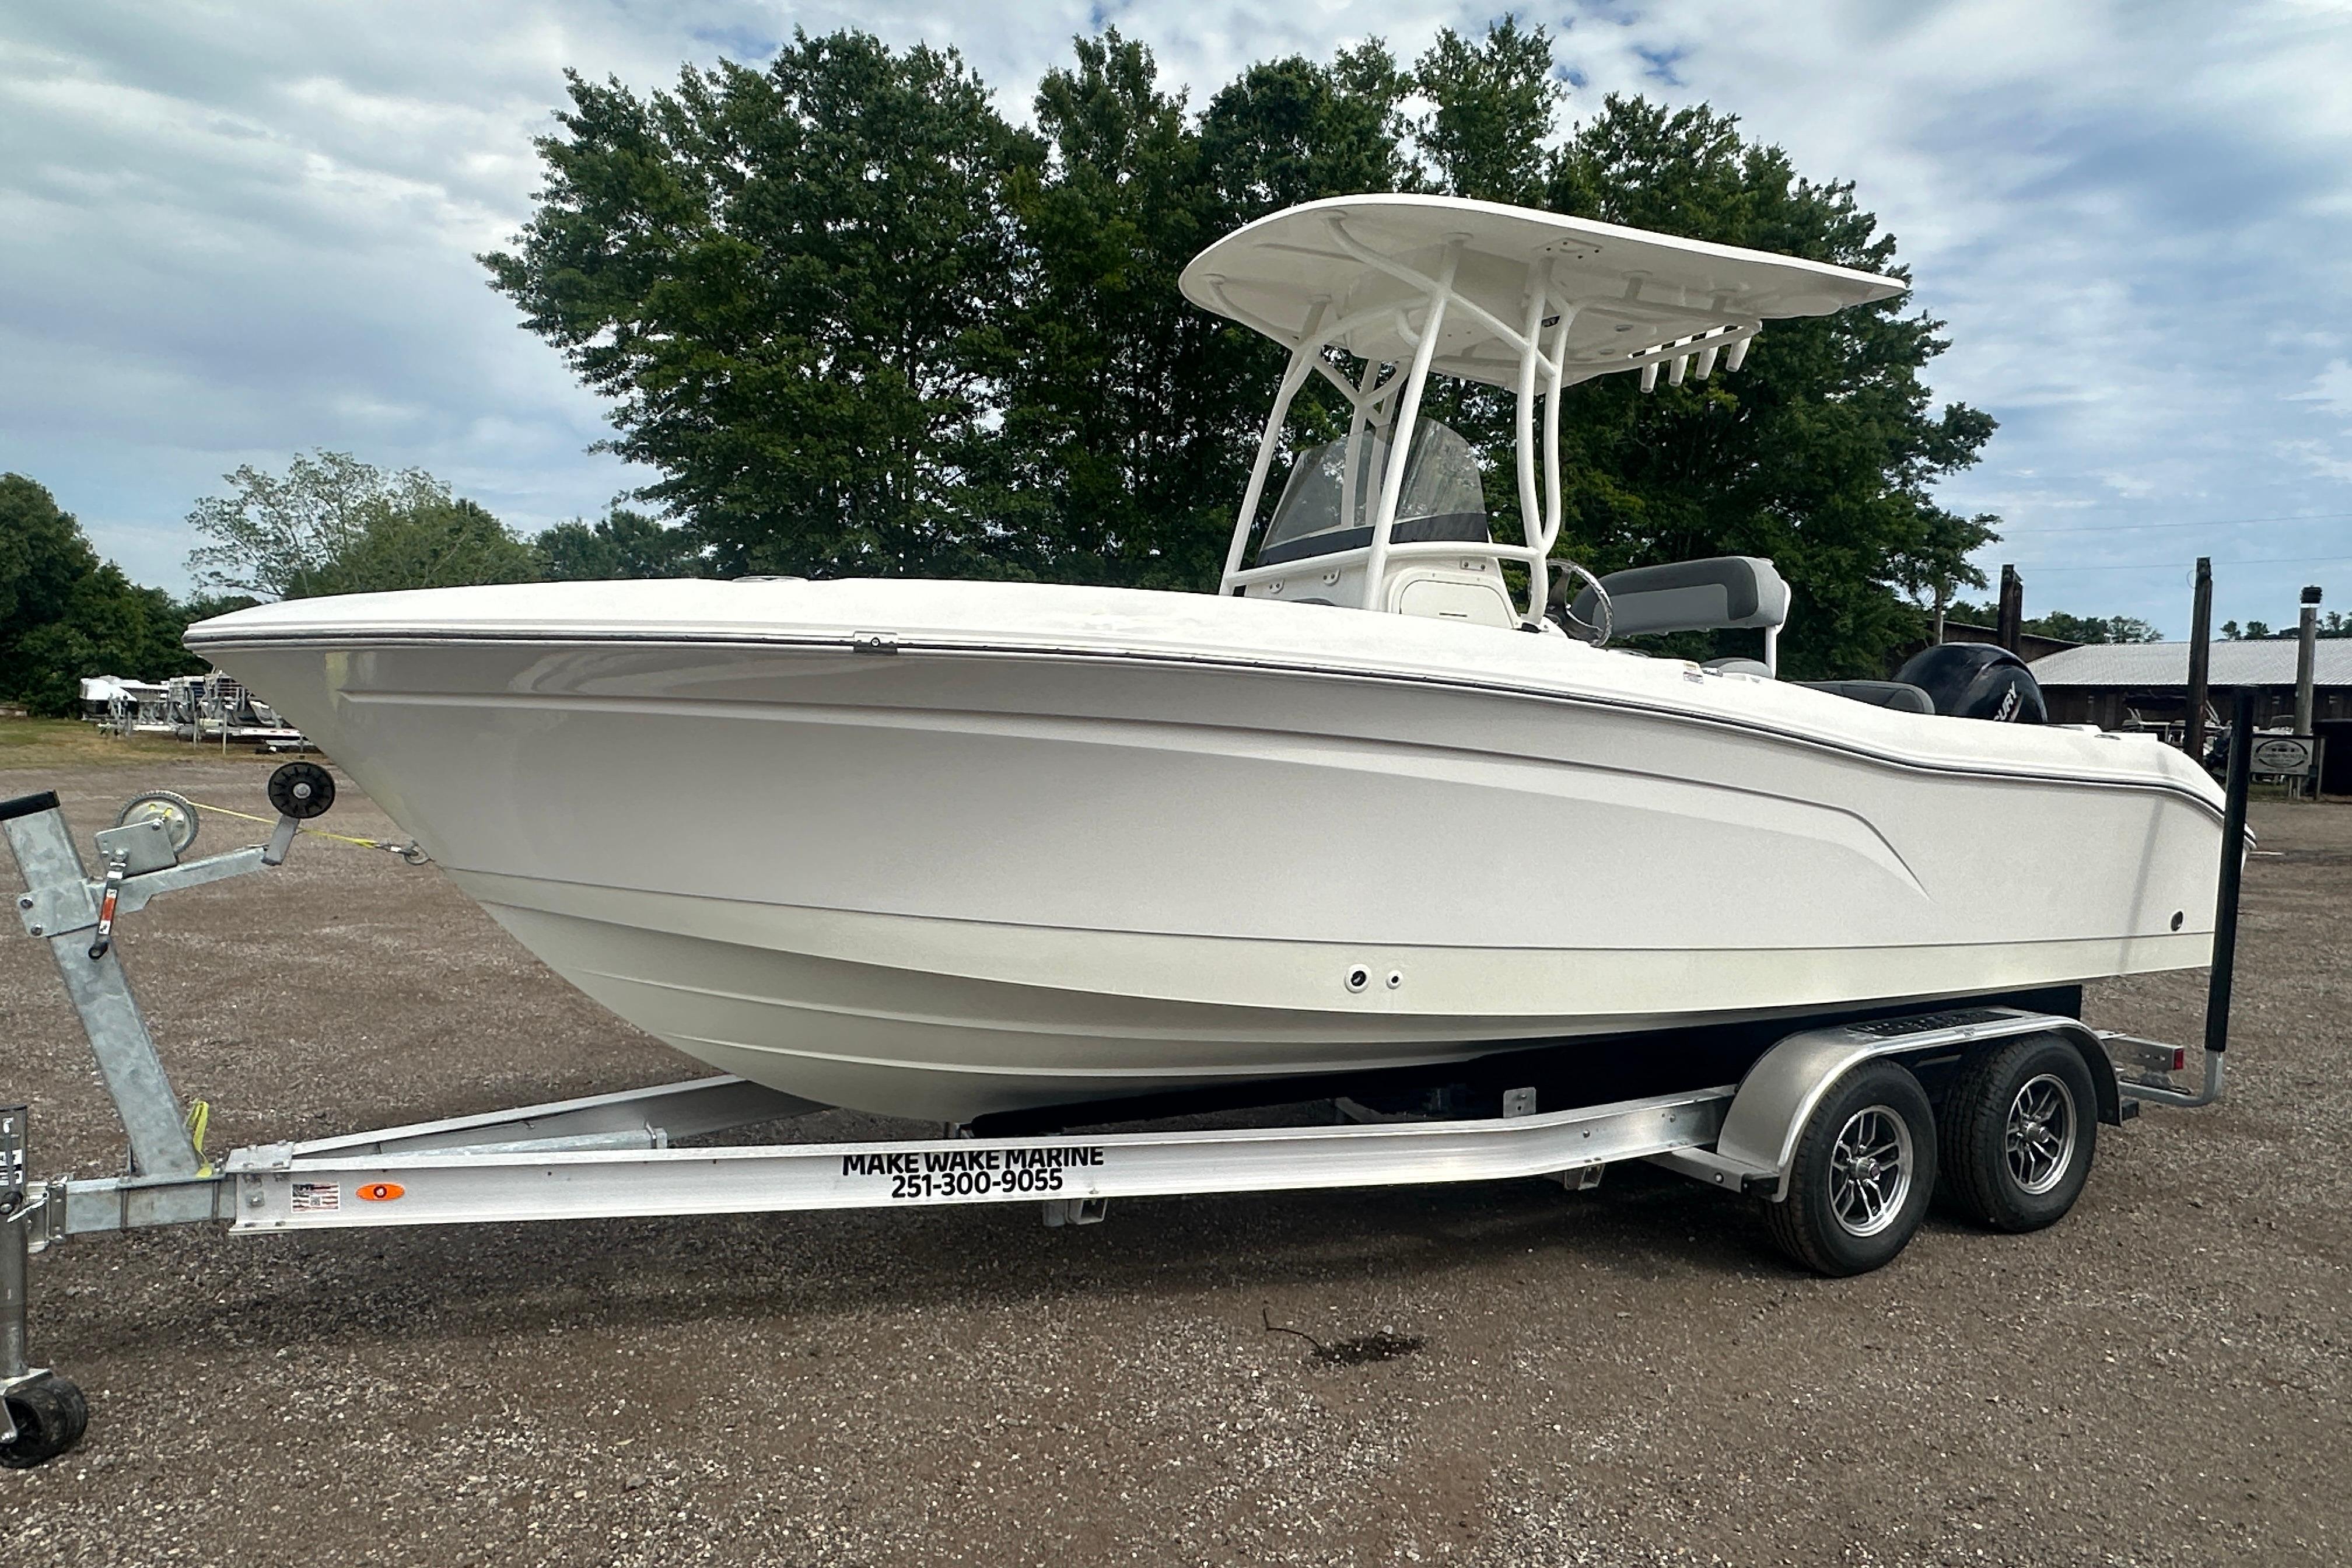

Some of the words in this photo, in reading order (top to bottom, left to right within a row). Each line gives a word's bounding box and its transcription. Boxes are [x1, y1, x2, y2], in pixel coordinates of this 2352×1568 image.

[842, 1153, 921, 1176] MAKE
[924, 1150, 1000, 1172] WAKE
[1005, 1146, 1104, 1169] MARINE
[891, 1168, 1063, 1198] 251-300-9055
